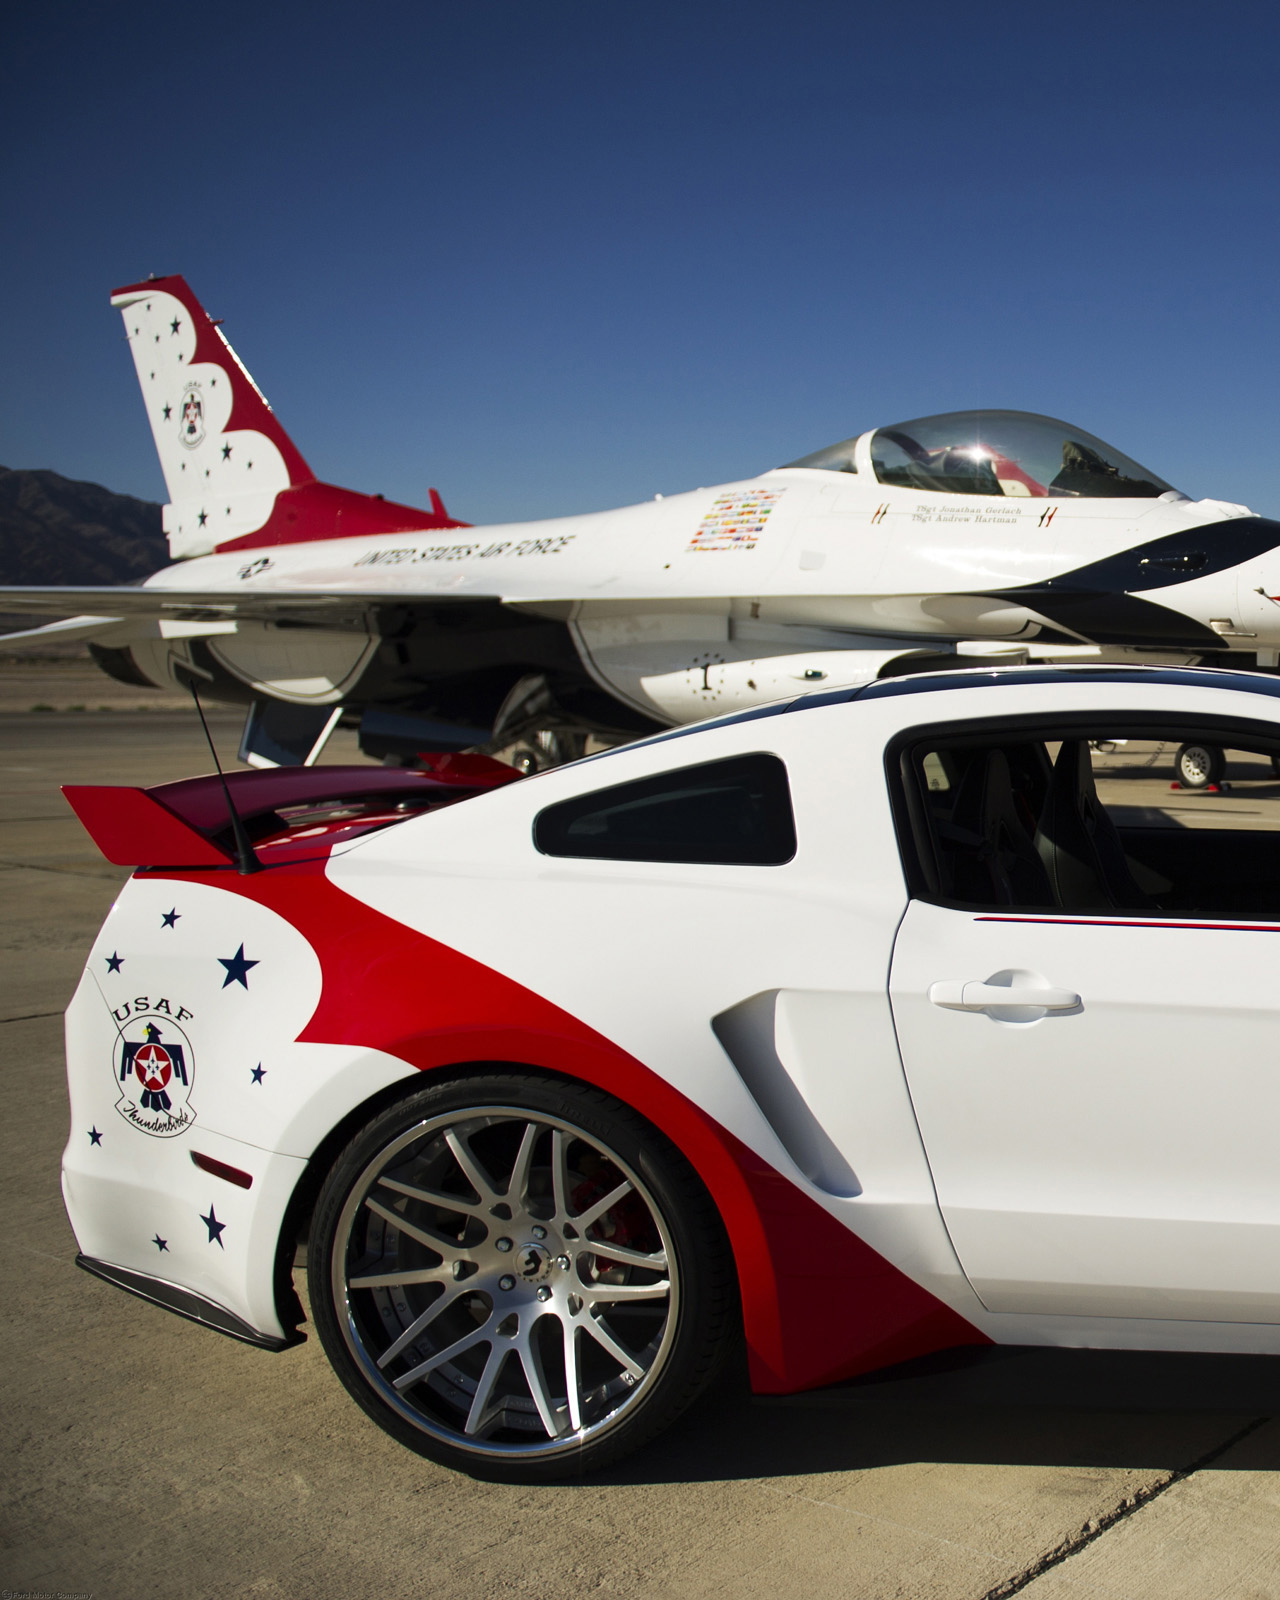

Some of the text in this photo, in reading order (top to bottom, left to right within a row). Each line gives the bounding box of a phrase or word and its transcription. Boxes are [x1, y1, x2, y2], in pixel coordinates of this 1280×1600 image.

[911, 514, 1018, 524] TSgt Andrew Hartman
[916, 505, 1022, 514] TSgt Jonathan Gerlach
[353, 534, 577, 567] UNITED STATES AIR FORCE
[700, 663, 713, 690] 1
[112, 996, 194, 1022] USAF
[123, 1099, 189, 1132] Thunderbirds
